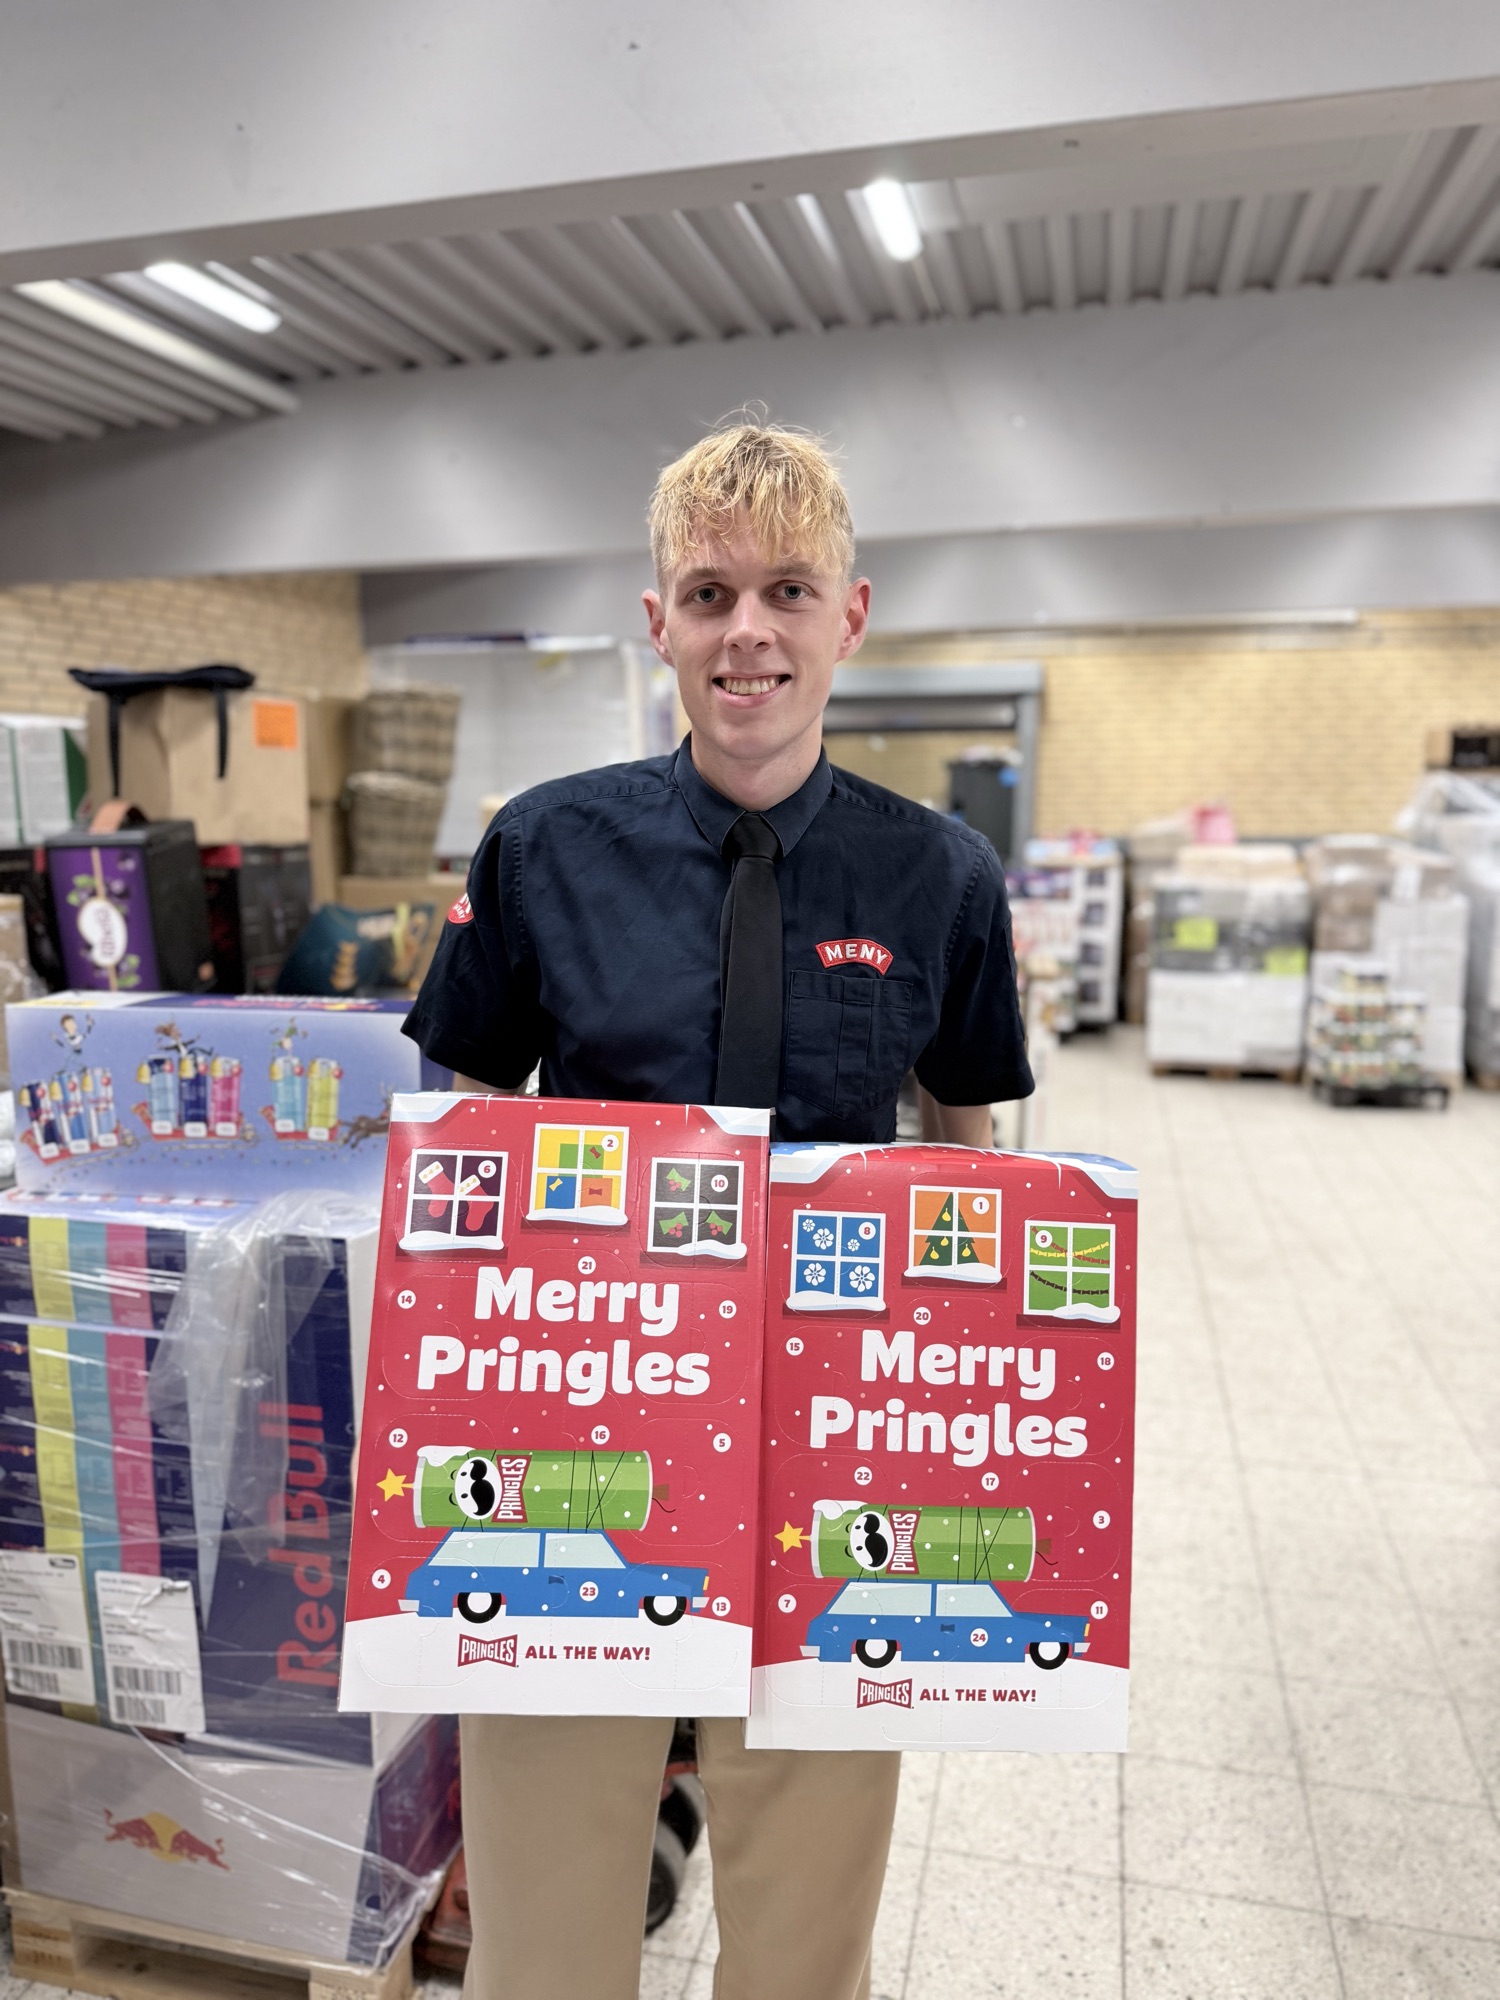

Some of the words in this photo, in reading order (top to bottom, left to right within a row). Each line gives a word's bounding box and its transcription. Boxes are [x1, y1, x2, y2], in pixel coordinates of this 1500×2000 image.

[824, 944, 888, 965] MENY
[606, 1138, 614, 1149] 2
[482, 1164, 491, 1175] 6
[713, 1178, 726, 1190] 10
[978, 1201, 984, 1211] 1
[863, 1226, 871, 1236] 8
[1040, 1233, 1048, 1244] 9
[581, 1260, 593, 1271] 21
[400, 1294, 413, 1305] 14
[475, 1267, 679, 1336] Merry
[721, 1304, 733, 1316] 19
[915, 1311, 929, 1322] 20
[789, 1342, 801, 1352] 15
[861, 1330, 1056, 1400] Merry
[1100, 1356, 1111, 1367] 18
[418, 1335, 710, 1406] Pringles
[594, 1430, 607, 1441] 16
[810, 1396, 1088, 1467] Pringles
[392, 1433, 405, 1444] 12
[718, 1437, 726, 1448] 5
[259, 1400, 329, 1539] Bull
[856, 1471, 870, 1482] 22
[984, 1476, 996, 1487] 17
[498, 1458, 526, 1521] PRINGLES
[1097, 1515, 1106, 1525] 3
[892, 1512, 917, 1572] PRINGLES
[376, 1574, 386, 1585] 4
[581, 1586, 596, 1597] 23
[715, 1601, 728, 1612] 13
[783, 1598, 791, 1609] 7
[1095, 1605, 1104, 1616] 11
[268, 1548, 339, 1687] Red
[972, 1632, 987, 1643] 24
[460, 1637, 517, 1665] PRINGLES
[526, 1647, 557, 1659] ALL
[563, 1647, 596, 1659] THE
[603, 1647, 650, 1660] WAY!
[860, 1680, 910, 1706] PRINGLES
[920, 1690, 949, 1701] ALL
[955, 1690, 987, 1701] THE
[993, 1690, 1036, 1702] WAY!
